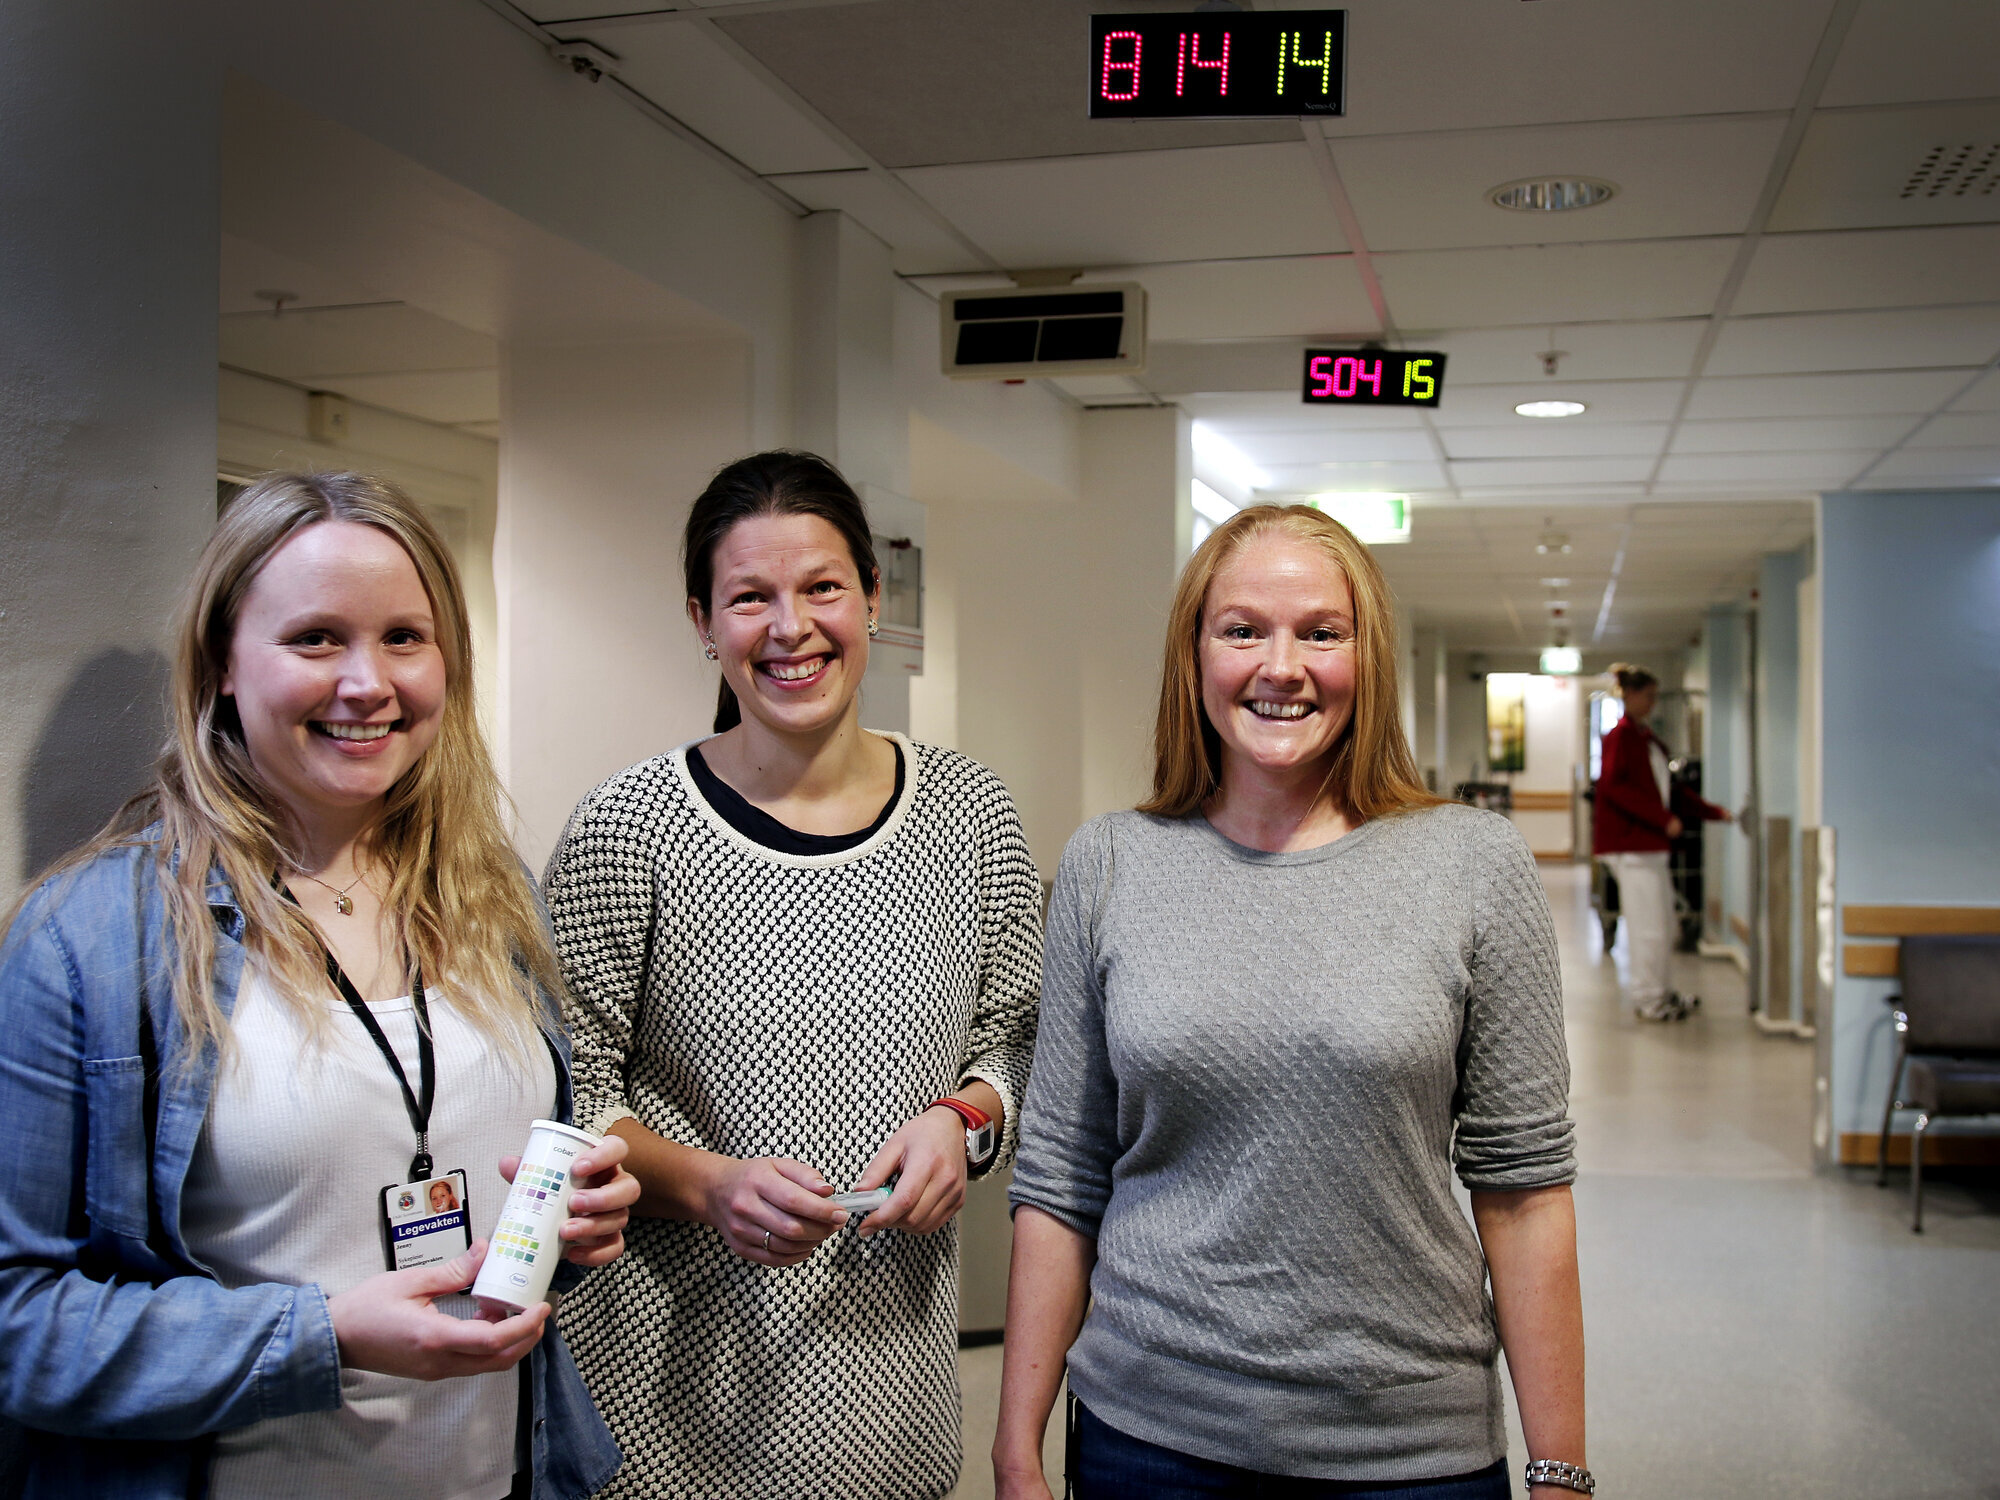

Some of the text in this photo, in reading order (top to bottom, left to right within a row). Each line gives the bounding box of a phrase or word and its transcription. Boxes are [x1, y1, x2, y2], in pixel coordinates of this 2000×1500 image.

[1276, 31, 1332, 95] 14
[1403, 359, 1435, 399] 15
[398, 1216, 460, 1237] Legevakten
